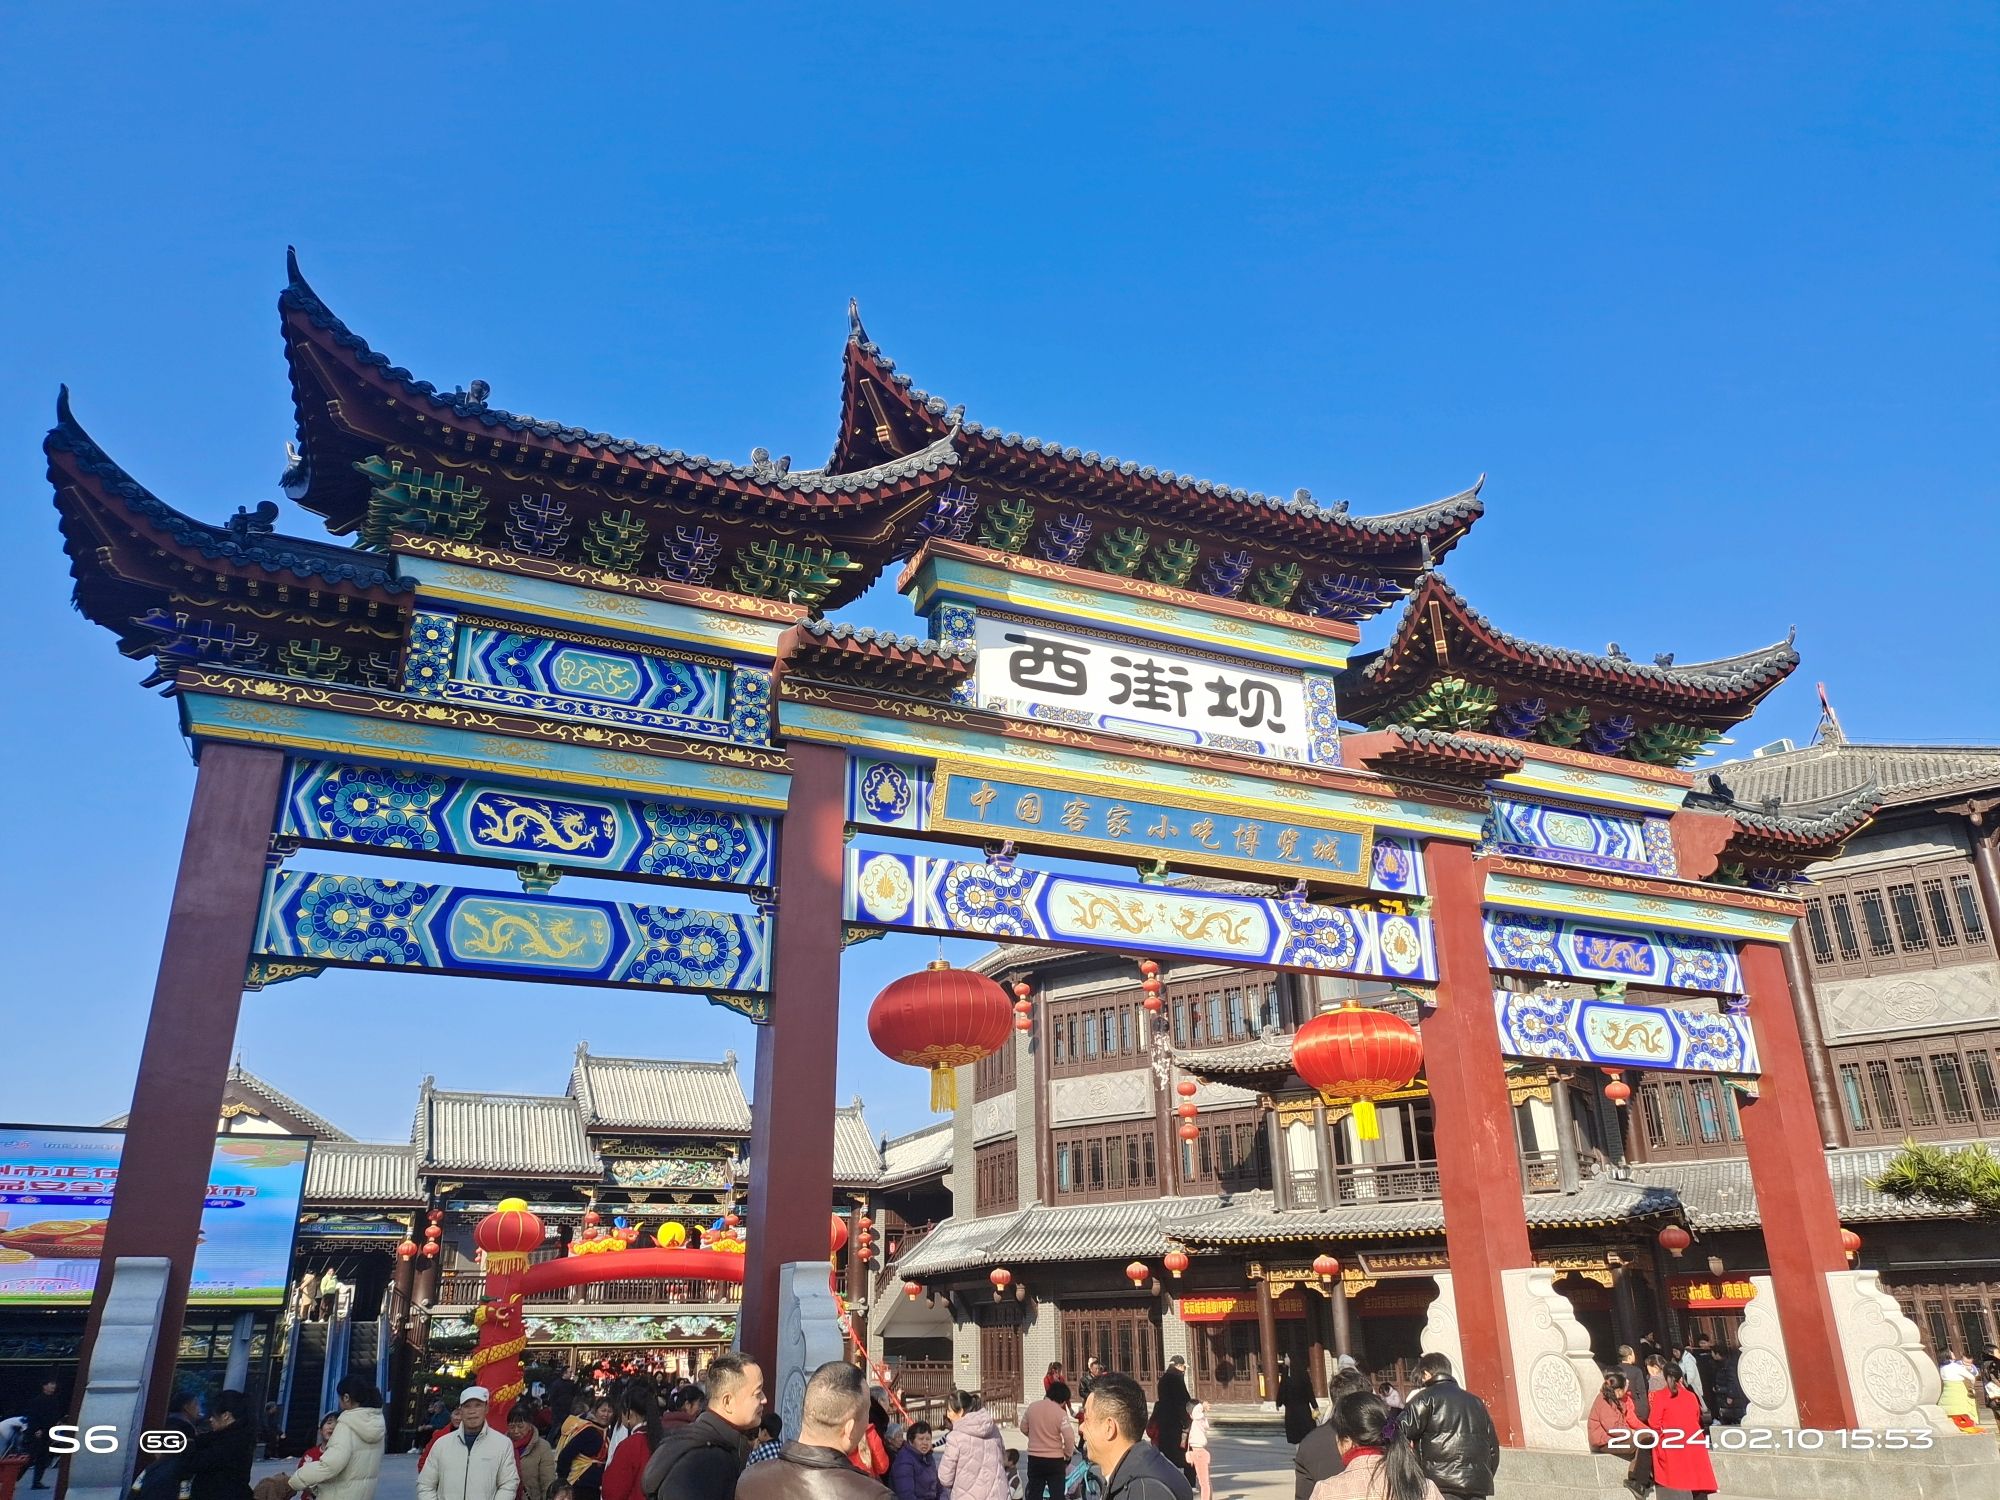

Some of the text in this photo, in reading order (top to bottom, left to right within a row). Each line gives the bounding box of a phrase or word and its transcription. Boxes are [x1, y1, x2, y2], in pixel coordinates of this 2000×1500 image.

[1004, 632, 1286, 734] 西街坝
[968, 781, 1344, 870] 中国客家小吃博览城
[0, 1165, 119, 1179] 市正在
[0, 1179, 116, 1193] 品安全
